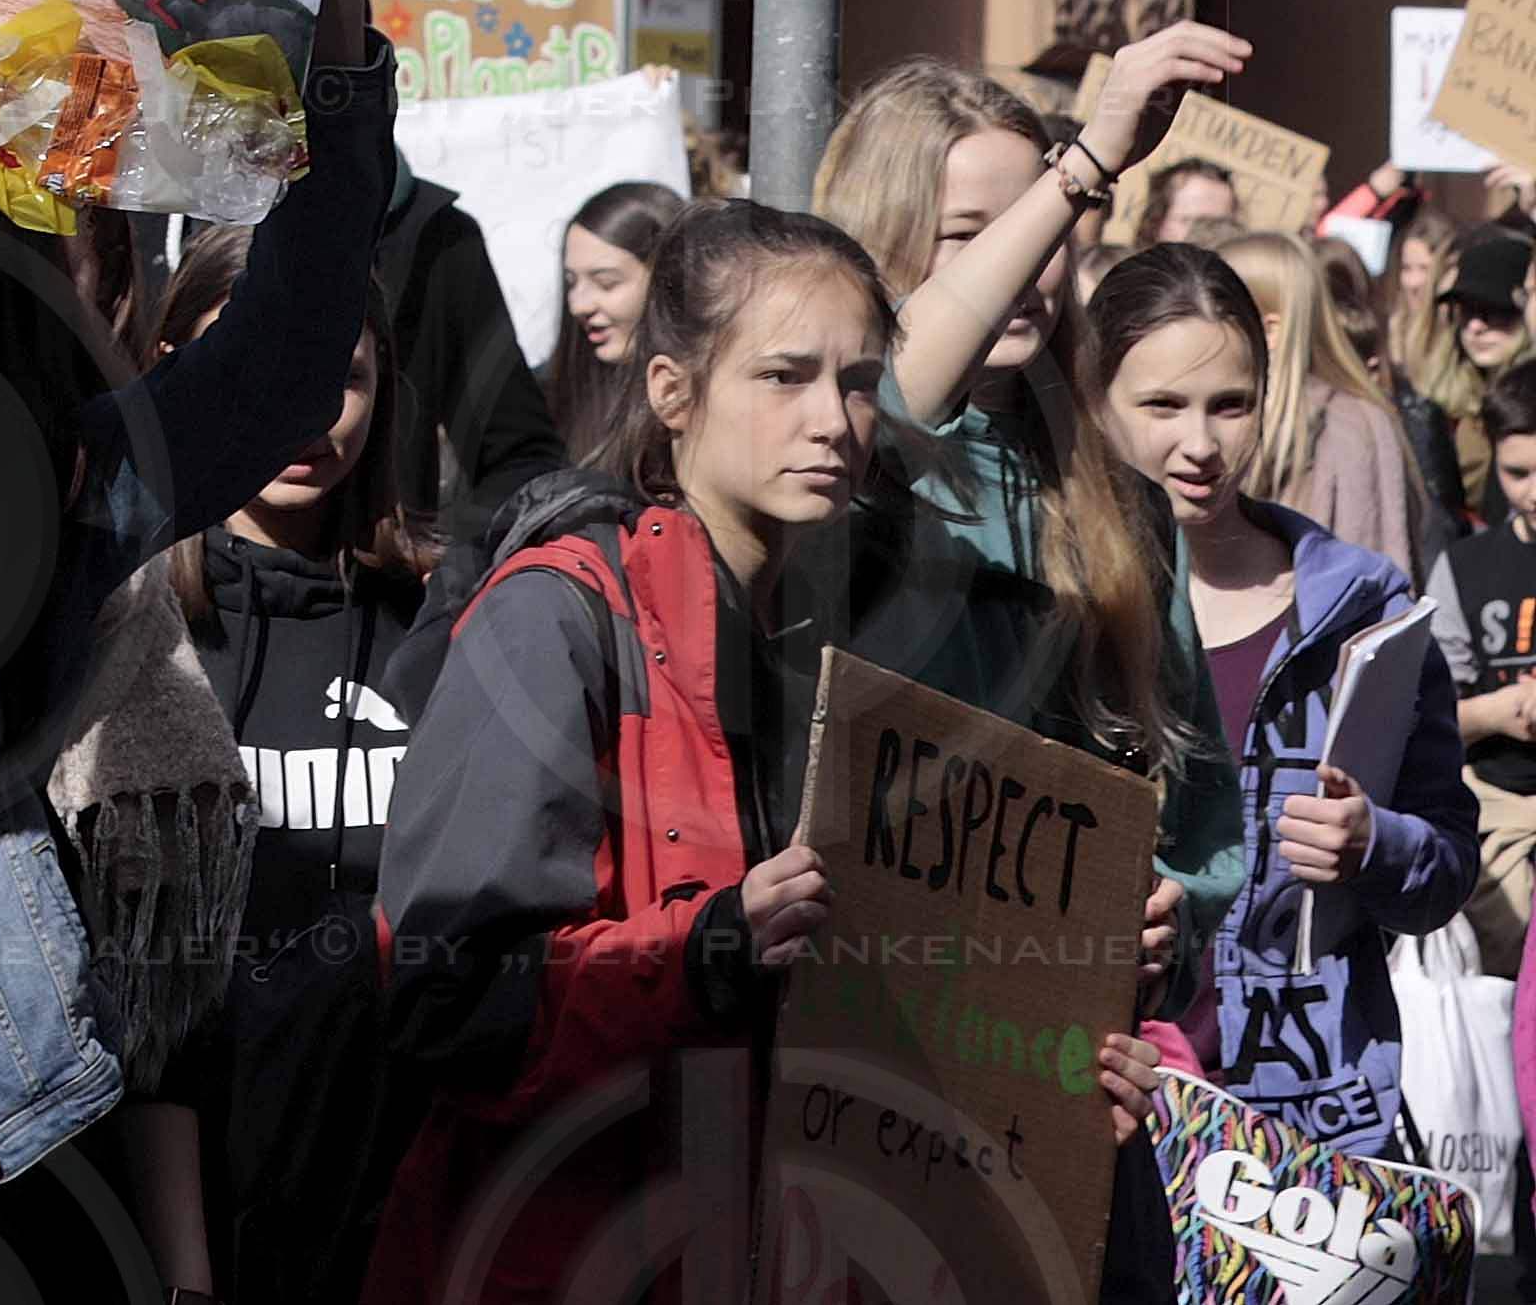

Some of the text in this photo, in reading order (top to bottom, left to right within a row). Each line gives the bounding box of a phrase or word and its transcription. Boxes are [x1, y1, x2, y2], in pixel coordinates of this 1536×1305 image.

[863, 727, 1099, 916] RESPECT
[877, 1114, 1026, 1182] expect
[1268, 1077, 1381, 1140] NCE
[1195, 1149, 1419, 1287] Gola
